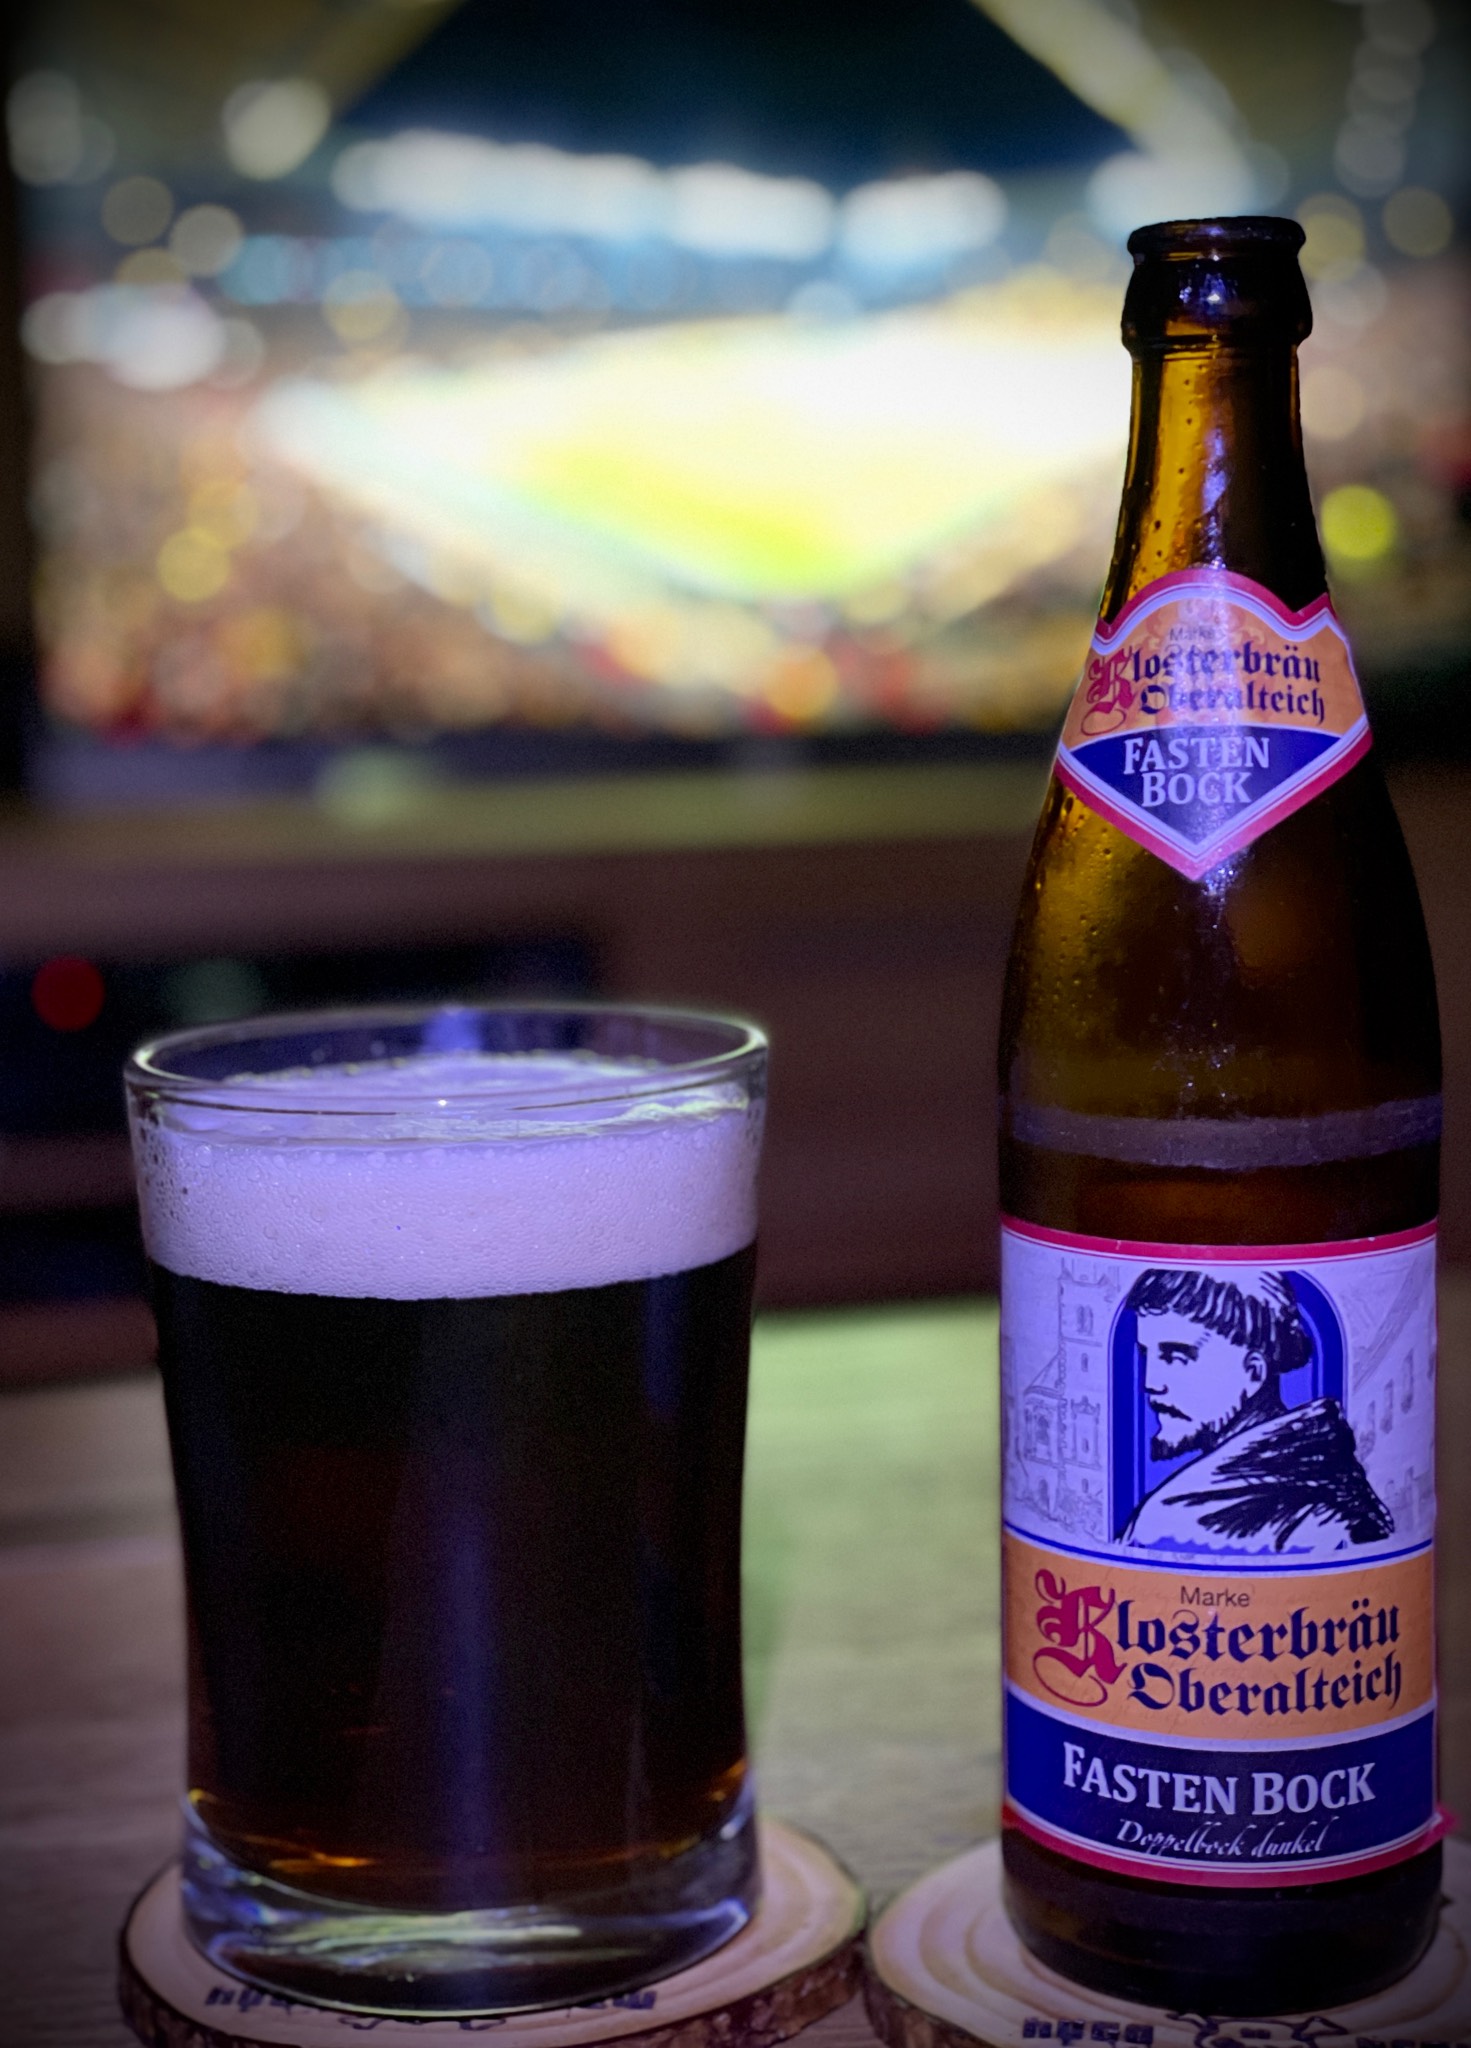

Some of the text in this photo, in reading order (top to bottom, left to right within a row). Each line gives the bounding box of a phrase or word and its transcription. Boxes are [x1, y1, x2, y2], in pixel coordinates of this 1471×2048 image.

[1081, 640, 1321, 736] Klosterbräu
[1140, 685, 1325, 725] Oberalteich
[1123, 737, 1270, 774] FASTEN
[1141, 771, 1251, 807] BOCK
[1180, 1586, 1250, 1607] Marke
[1033, 1569, 1401, 1707] Klosterbräu
[1127, 1650, 1402, 1717] Oberalteich
[1063, 1741, 1377, 1817] FASTEN BOCK
[1116, 1815, 1340, 1858] Doppelbock dunkel
